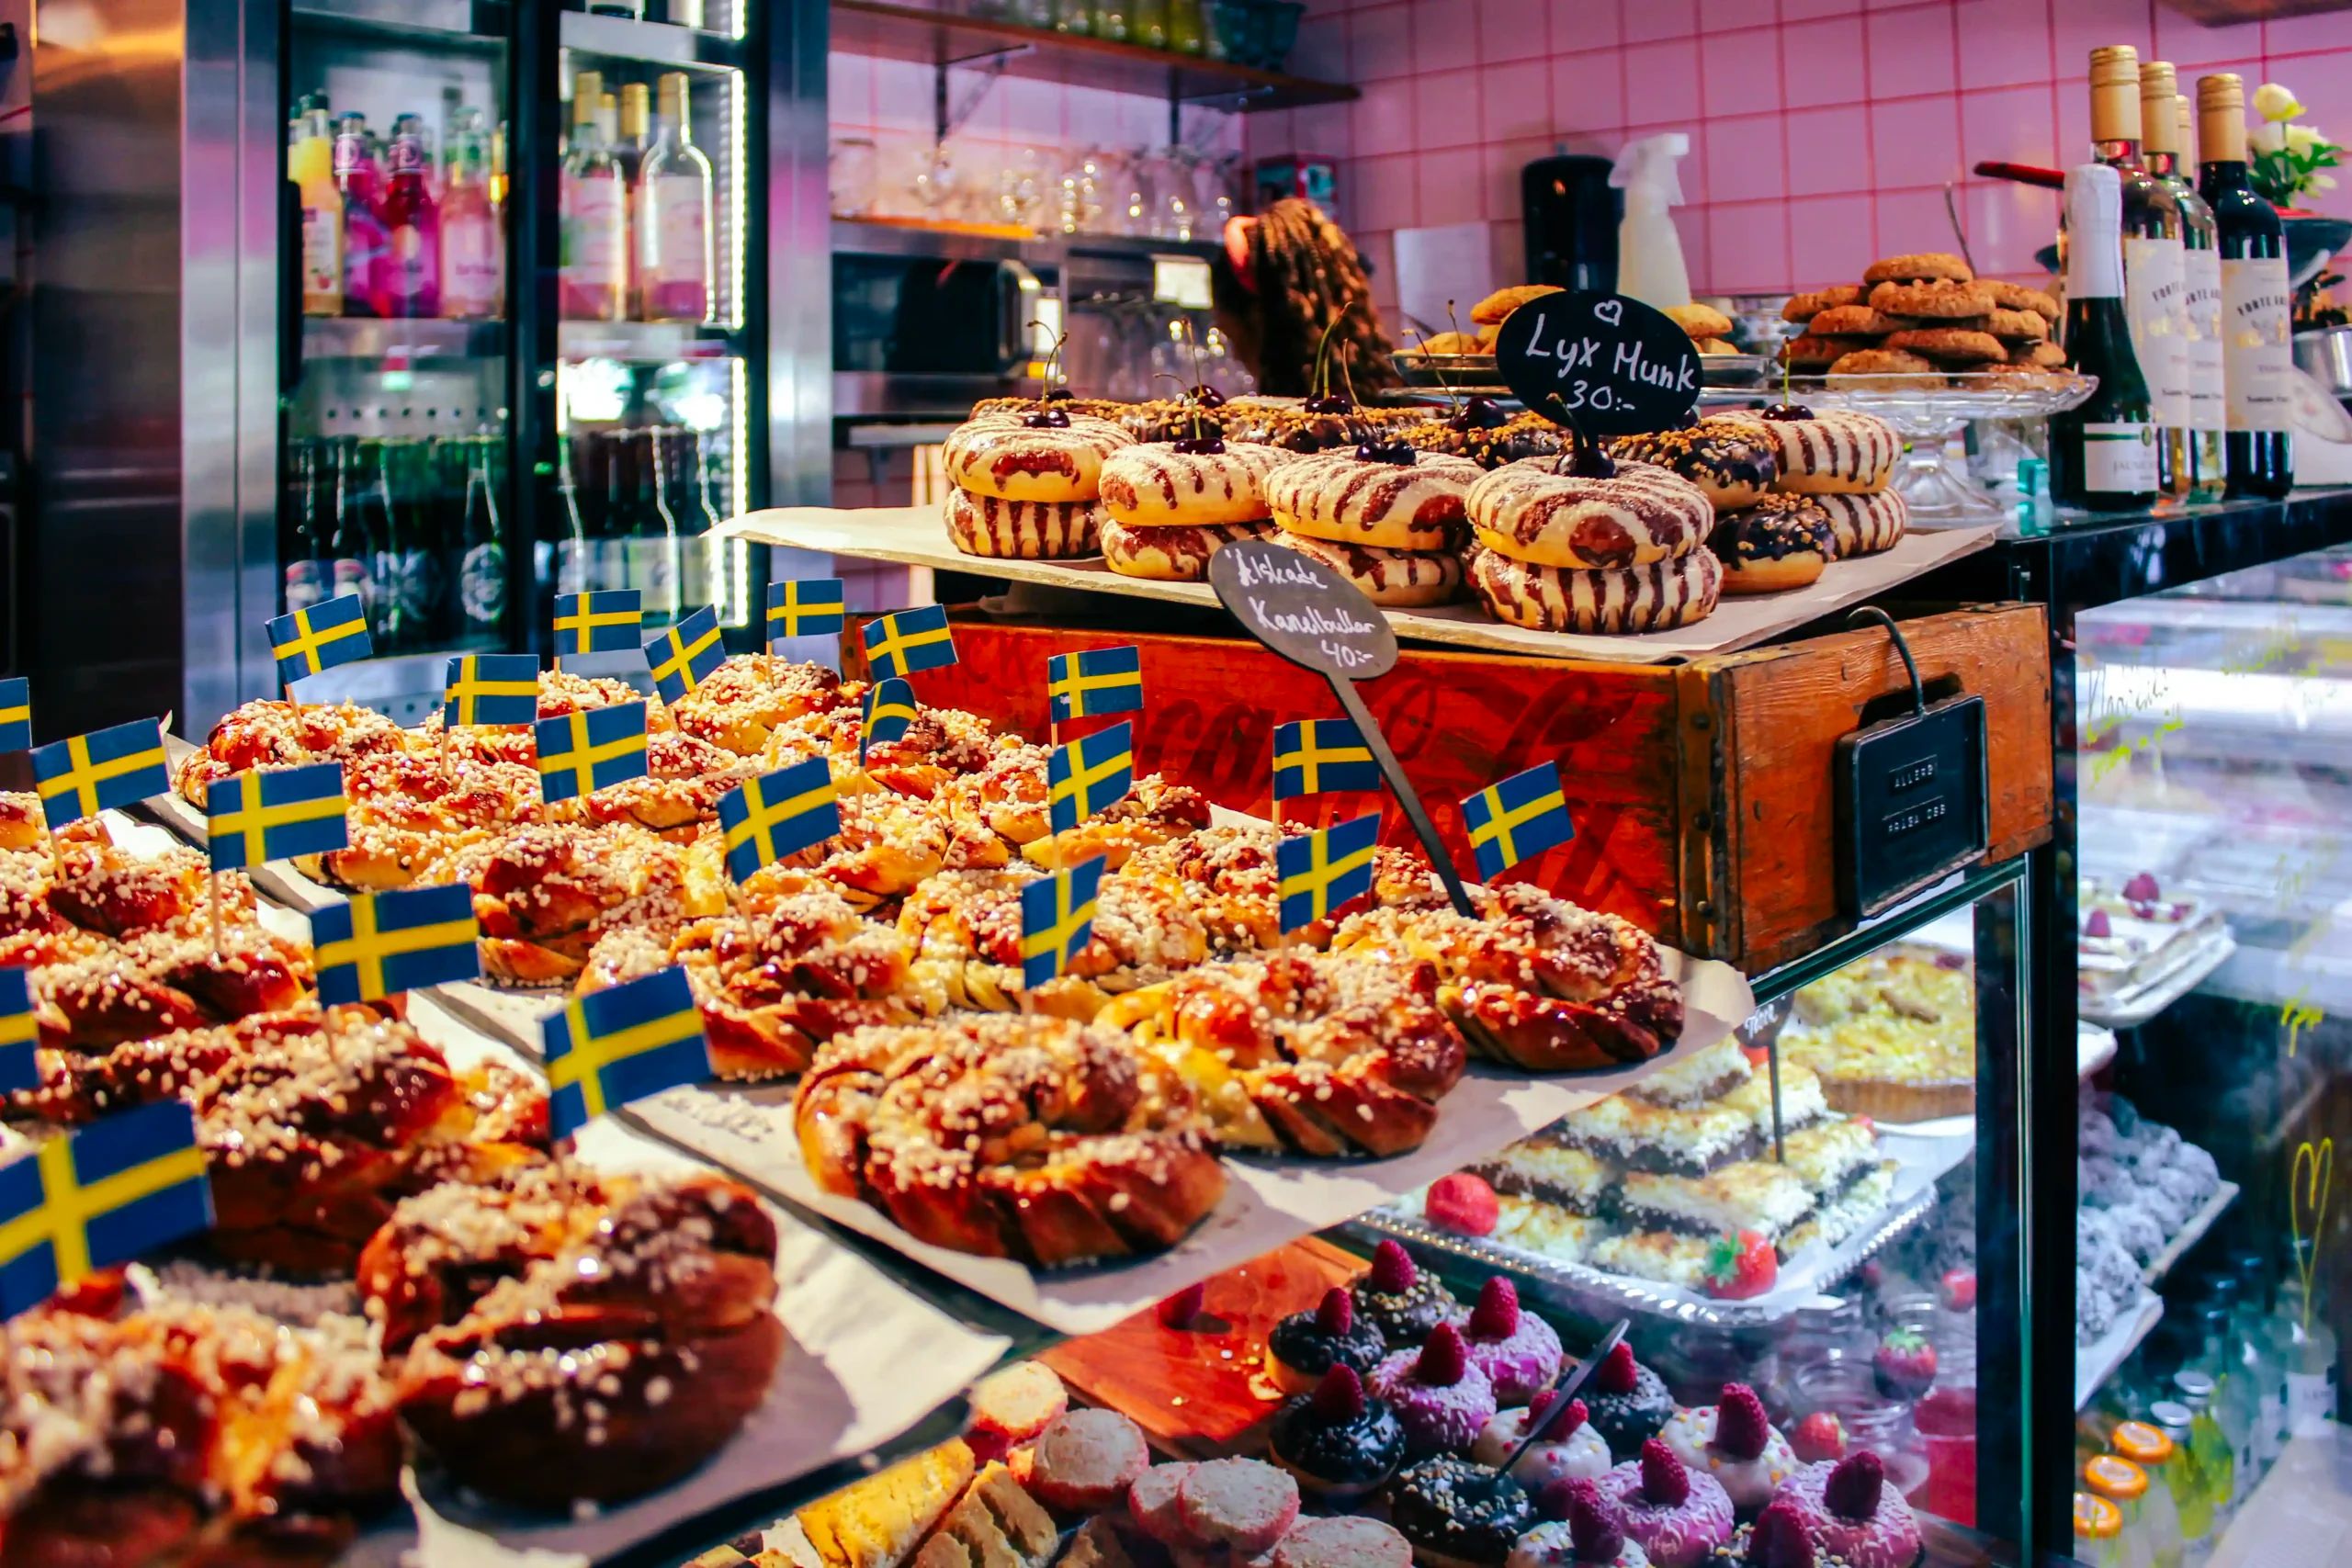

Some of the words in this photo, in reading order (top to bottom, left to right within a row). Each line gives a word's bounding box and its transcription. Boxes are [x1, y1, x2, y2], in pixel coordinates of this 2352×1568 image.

[1525, 313, 1600, 378] Lyx
[1613, 341, 1695, 392] Munk
[1566, 380, 1636, 411] 30:-
[1321, 639, 1374, 668] 40:-
